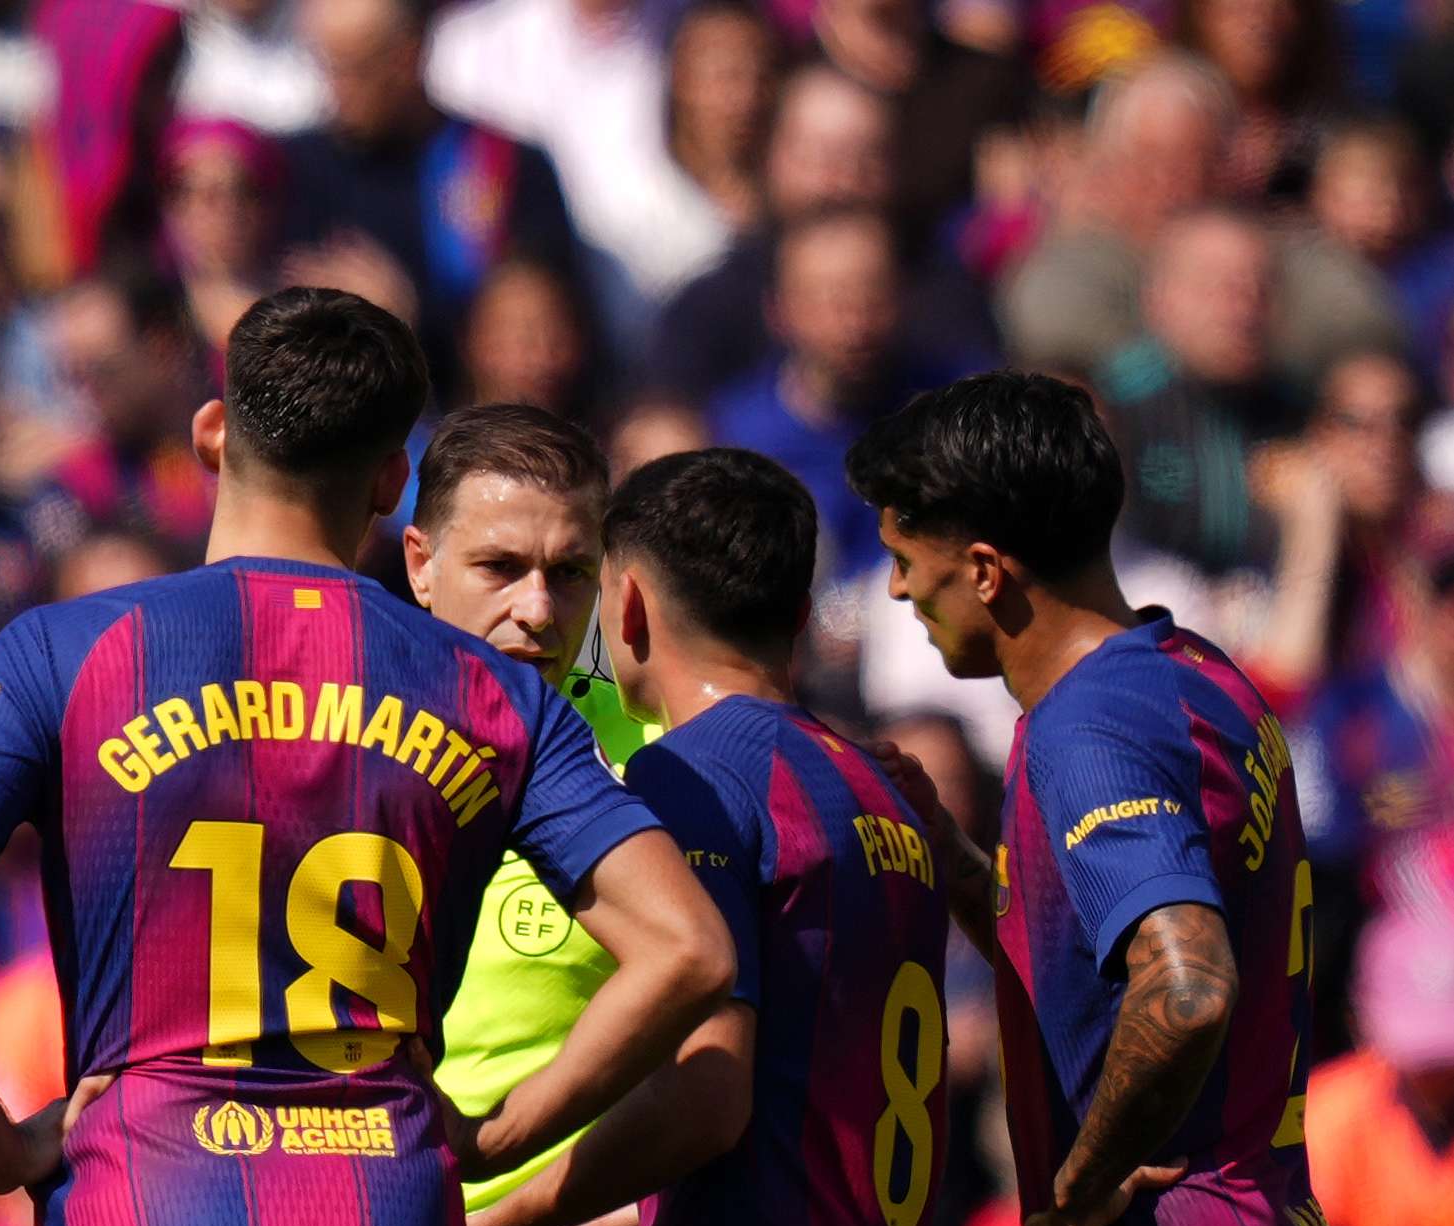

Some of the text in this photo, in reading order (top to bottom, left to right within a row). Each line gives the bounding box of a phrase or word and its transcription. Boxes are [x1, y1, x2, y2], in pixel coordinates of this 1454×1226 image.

[97, 680, 500, 829] GERARD MARTÍN
[853, 815, 934, 890] PEDRI
[1066, 798, 1181, 850] AMBILIGHT tv
[169, 820, 424, 1074] 18
[276, 1106, 391, 1129] UNHCR
[281, 1128, 395, 1149] ACNUR
